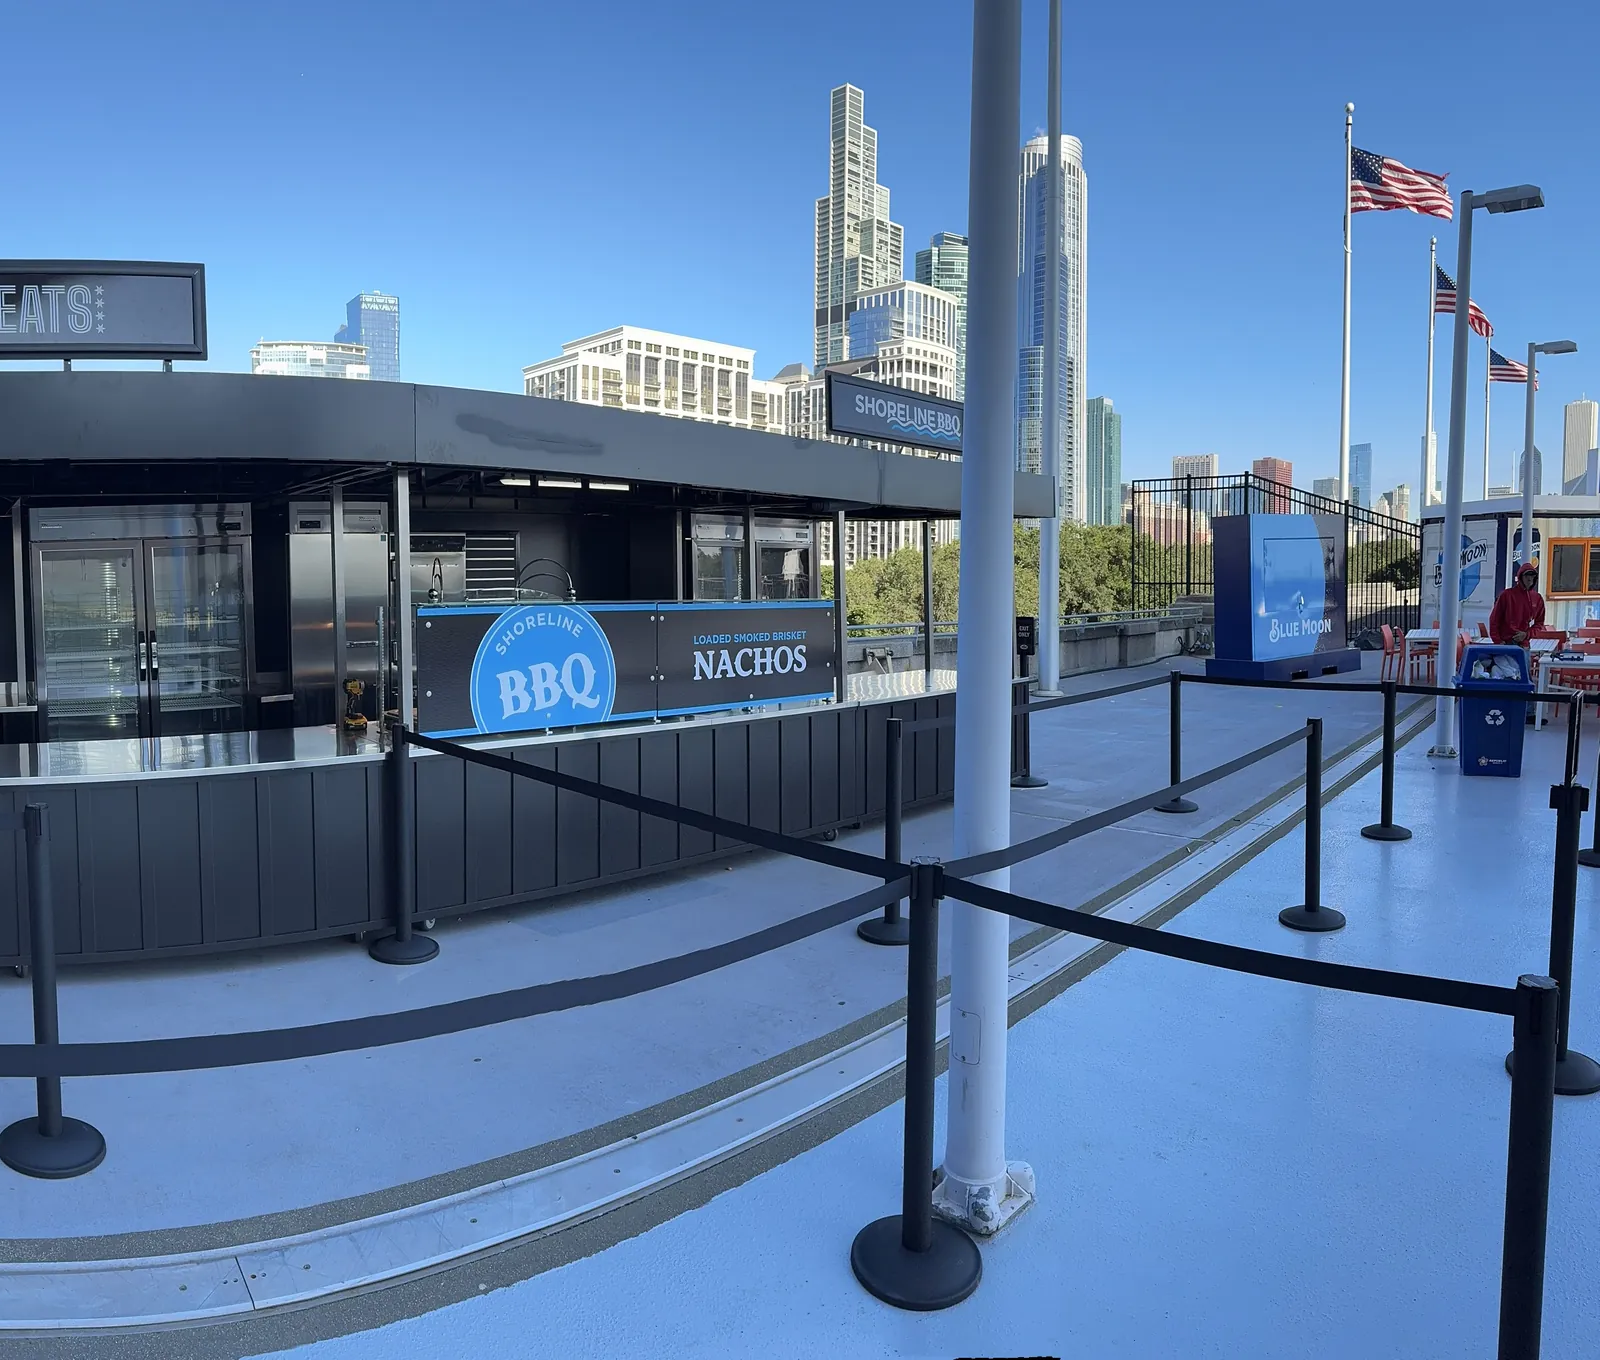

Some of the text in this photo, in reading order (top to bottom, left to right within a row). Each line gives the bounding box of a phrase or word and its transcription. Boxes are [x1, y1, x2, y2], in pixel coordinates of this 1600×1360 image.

[855, 394, 962, 437] SHORELINE BBQ
[495, 612, 584, 656] SHORELINE
[693, 630, 807, 645] LOADED SMOKED BRISKET
[693, 645, 807, 680] NACHOS
[496, 652, 600, 720] BBQ
